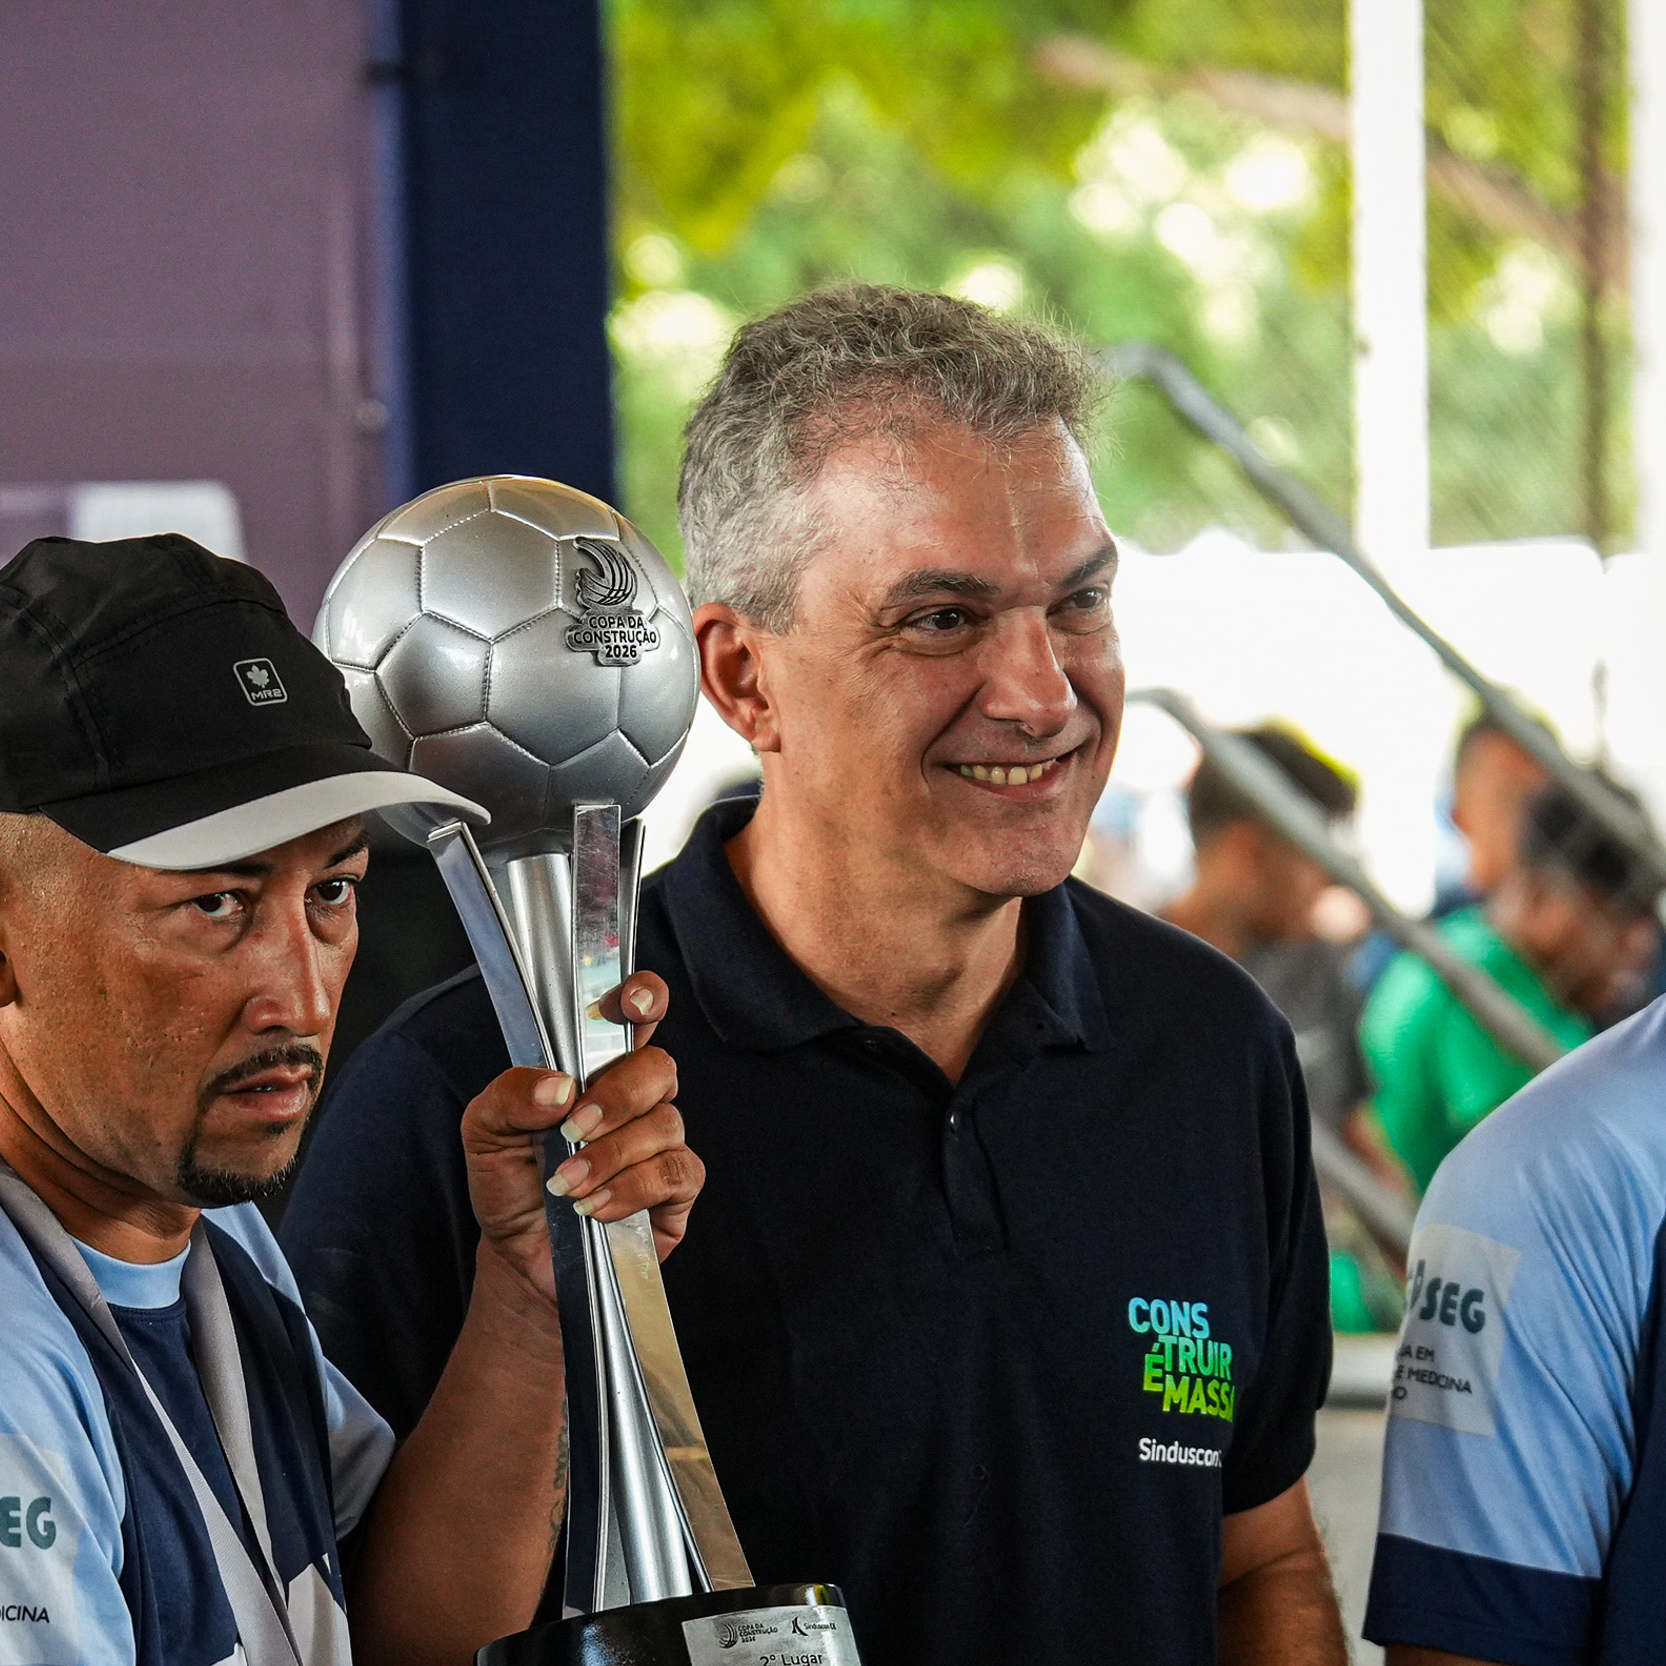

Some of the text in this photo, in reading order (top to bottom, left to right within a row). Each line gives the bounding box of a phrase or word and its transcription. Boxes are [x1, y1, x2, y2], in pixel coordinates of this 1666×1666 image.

[589, 616, 645, 629] COPA DA
[574, 627, 657, 646] CONSTRUÇÃO
[605, 645, 637, 658] 2026
[251, 688, 283, 701] MR2
[1128, 1296, 1211, 1339] CONS
[1158, 1335, 1233, 1380] TRUIR
